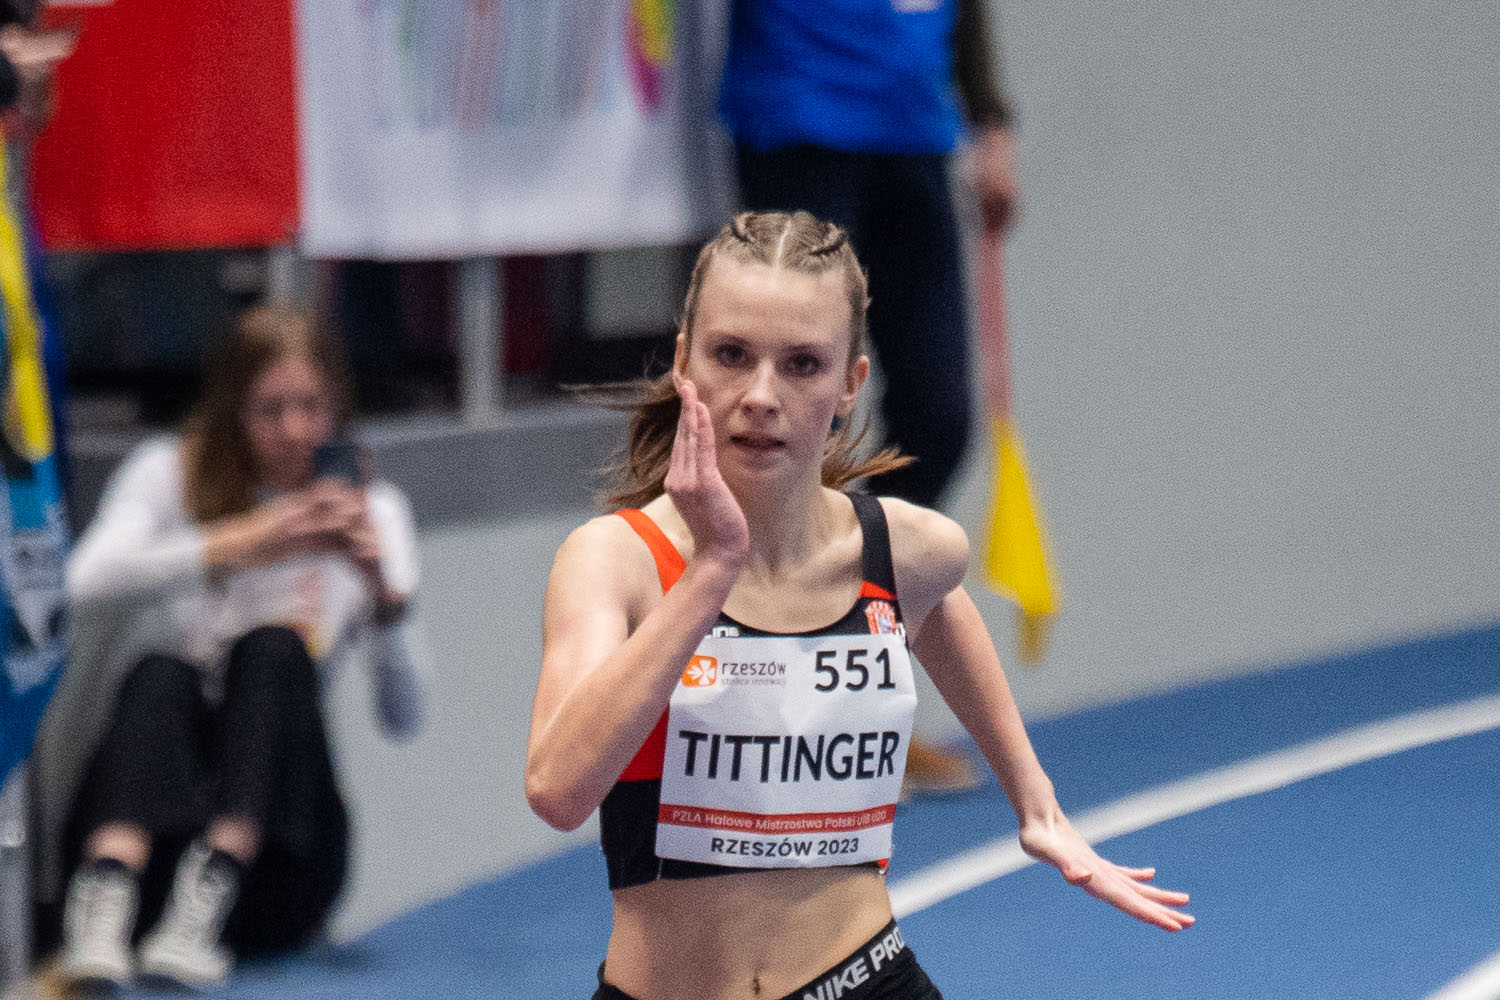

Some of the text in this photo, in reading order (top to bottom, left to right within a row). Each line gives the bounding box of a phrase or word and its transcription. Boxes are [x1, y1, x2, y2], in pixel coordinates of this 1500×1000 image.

[722, 648, 895, 692] rzeszów 551
[678, 730, 900, 783] TITTINGER
[711, 837, 860, 857] RZESZÓW 2023
